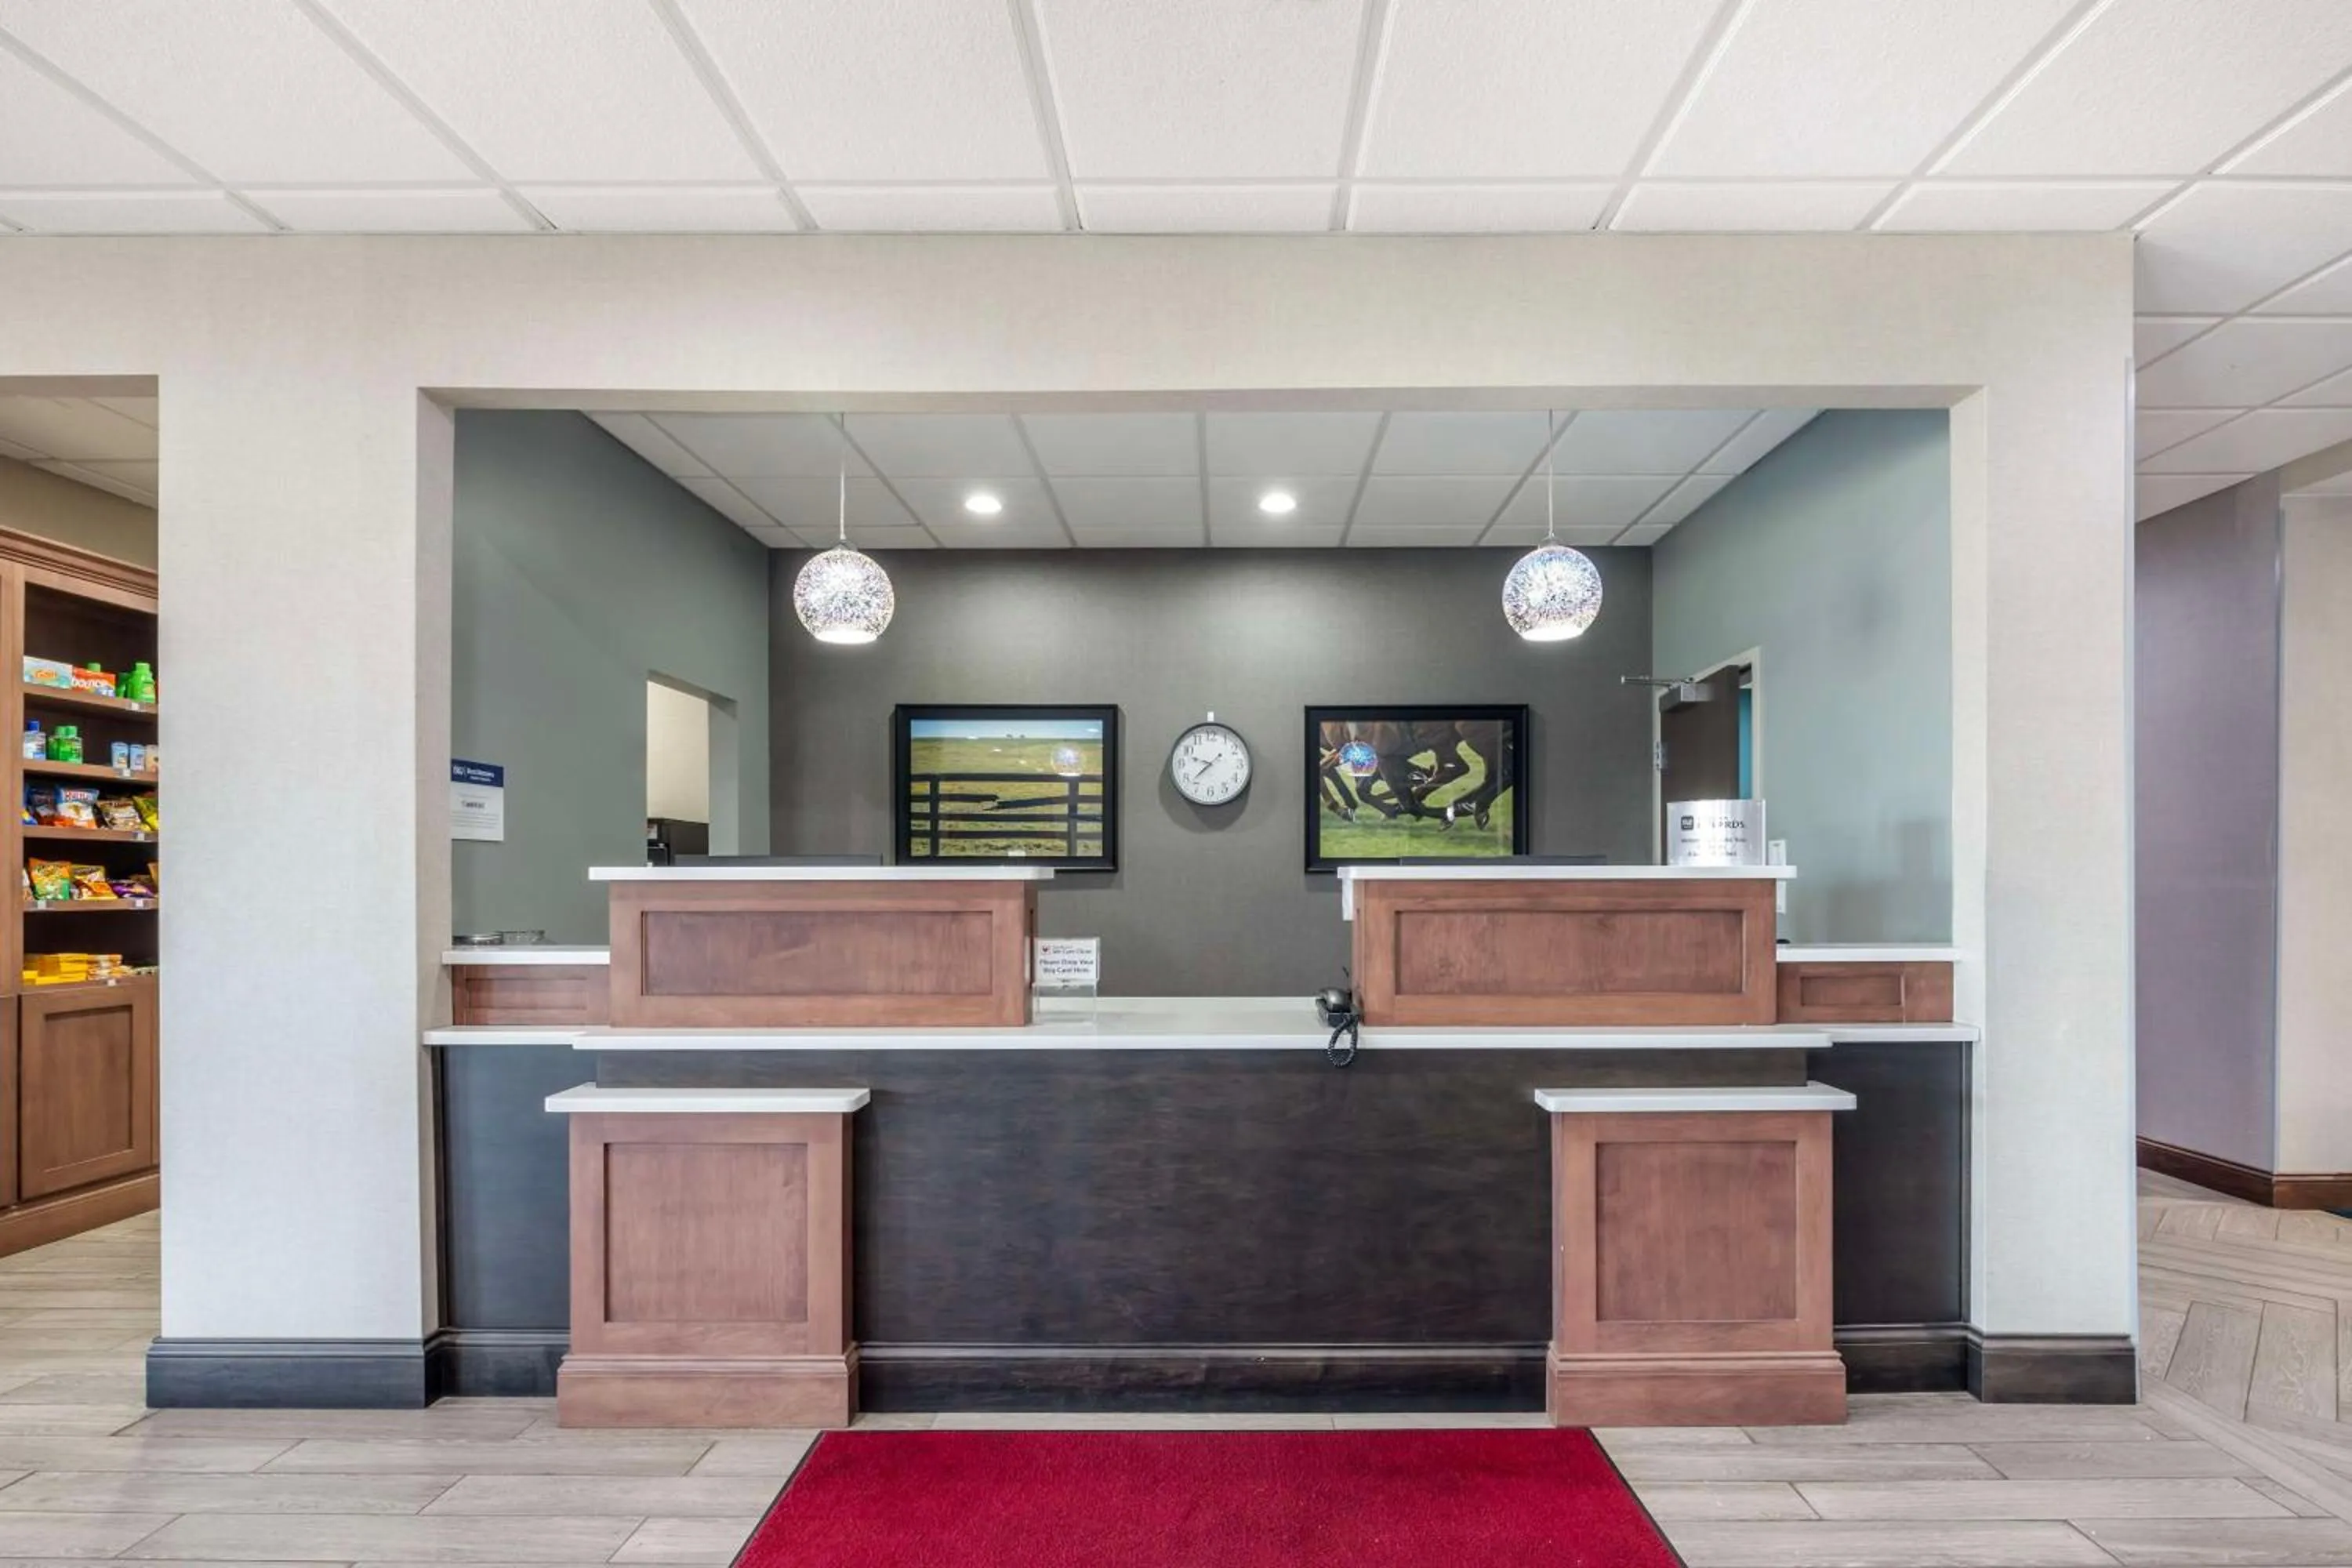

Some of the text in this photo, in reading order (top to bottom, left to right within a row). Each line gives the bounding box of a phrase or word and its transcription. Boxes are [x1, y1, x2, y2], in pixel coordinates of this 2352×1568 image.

[1193, 734, 1203, 746] 11
[1206, 730, 1217, 742] 12
[1223, 733, 1228, 745] 1
[1183, 746, 1193, 755] 10
[1230, 744, 1239, 755] 2
[1178, 758, 1185, 768] 9
[1236, 759, 1243, 769] 3
[1183, 772, 1189, 782] 8
[1231, 772, 1240, 783] 4
[1192, 782, 1200, 794] 7
[1207, 786, 1214, 797] 6
[1221, 782, 1229, 794] 5
